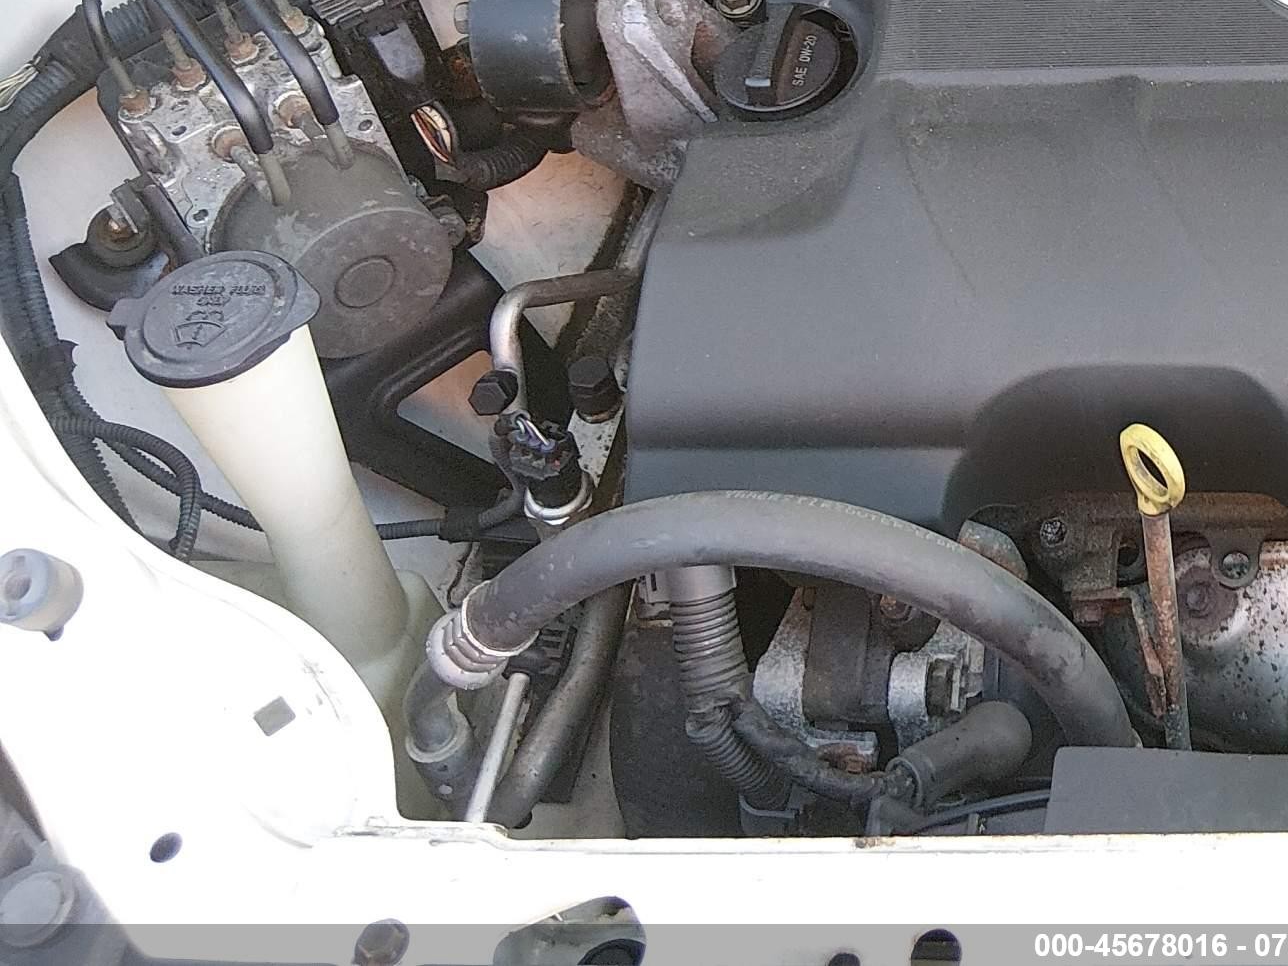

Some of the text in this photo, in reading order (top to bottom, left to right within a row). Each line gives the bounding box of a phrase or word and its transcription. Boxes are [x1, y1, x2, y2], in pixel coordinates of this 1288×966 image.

[791, 35, 817, 86] SAE 0W-20
[171, 284, 226, 296] WASHER
